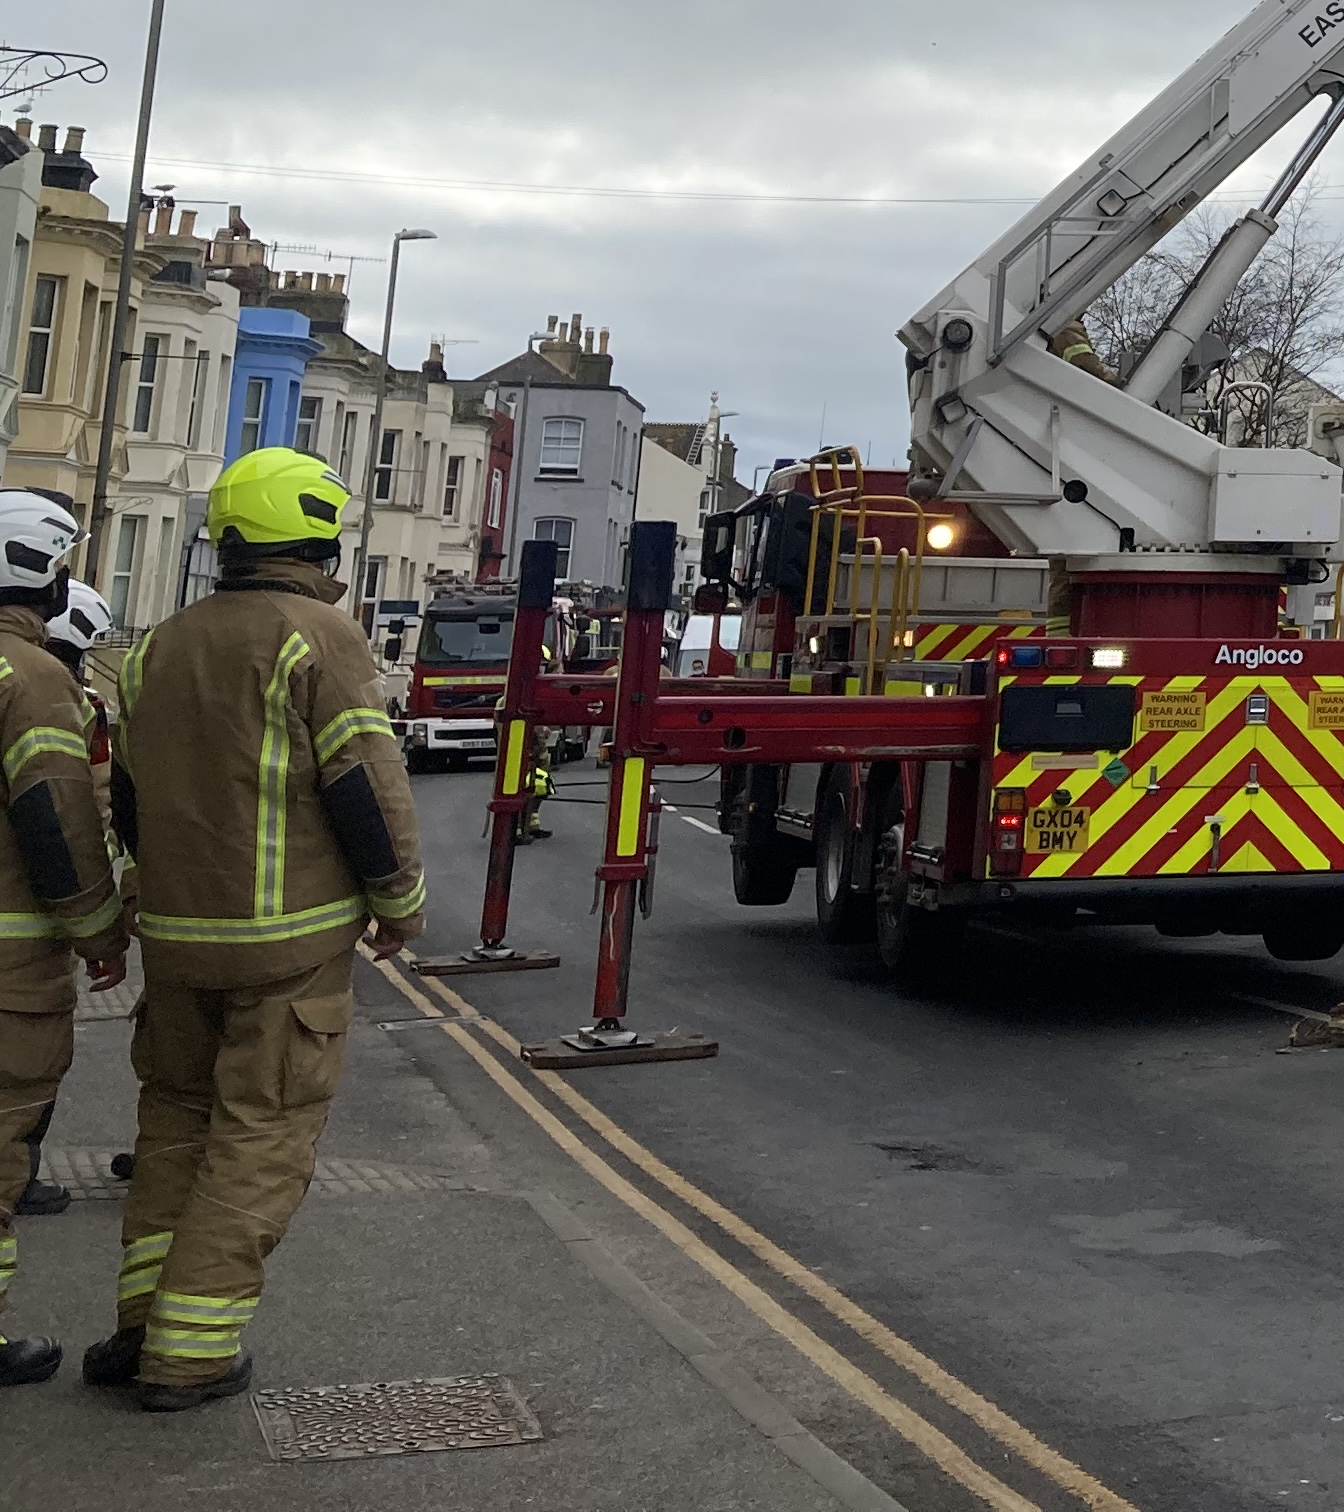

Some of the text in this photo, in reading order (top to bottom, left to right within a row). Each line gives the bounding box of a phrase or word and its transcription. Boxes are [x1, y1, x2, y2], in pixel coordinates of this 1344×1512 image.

[1215, 644, 1304, 669] Angloco
[1151, 694, 1198, 704] WARNING
[1145, 706, 1202, 716] REAR AXLE
[1316, 706, 1339, 714] REAR
[1148, 719, 1197, 728] STEERING
[1033, 809, 1086, 829] GX04
[1039, 830, 1078, 850] BMY
